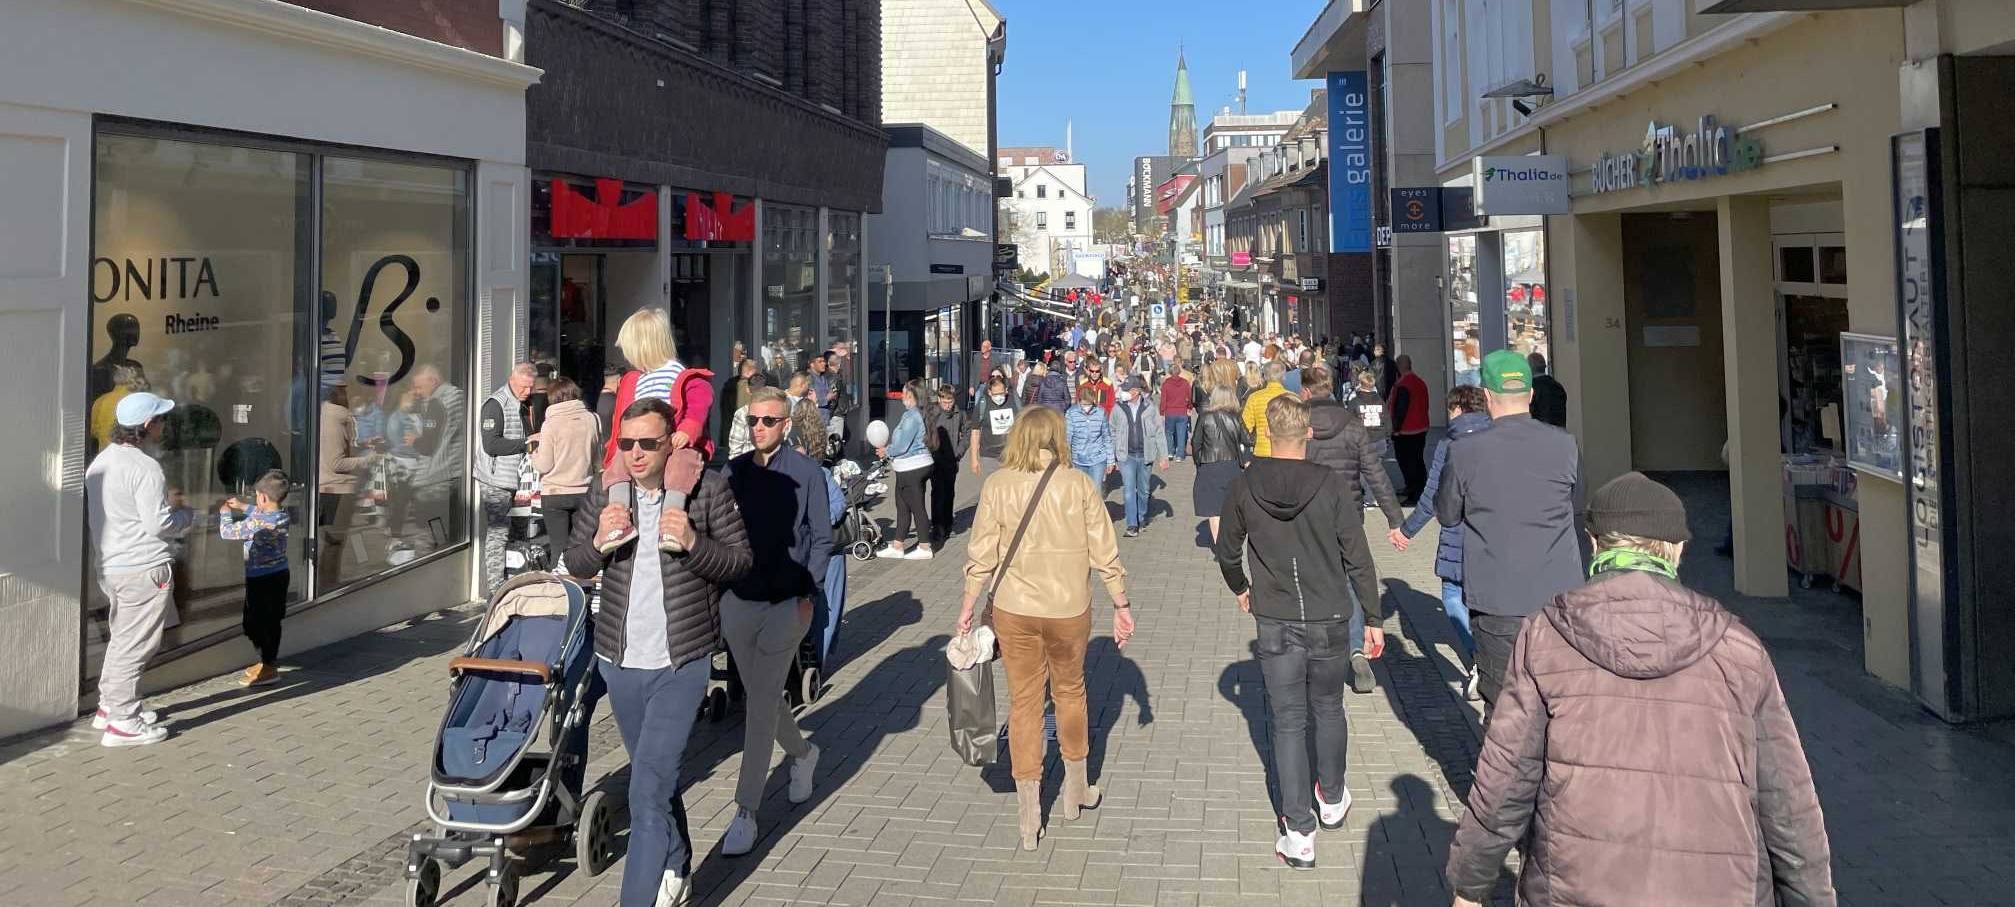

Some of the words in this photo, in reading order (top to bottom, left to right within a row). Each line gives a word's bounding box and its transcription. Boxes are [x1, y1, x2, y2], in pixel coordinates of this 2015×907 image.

[1497, 168, 1548, 182] Thalia
[1592, 153, 1635, 195] BÜCHER
[1401, 189, 1427, 198] eyes
[1401, 222, 1431, 230] more
[165, 313, 220, 335] Rheine
